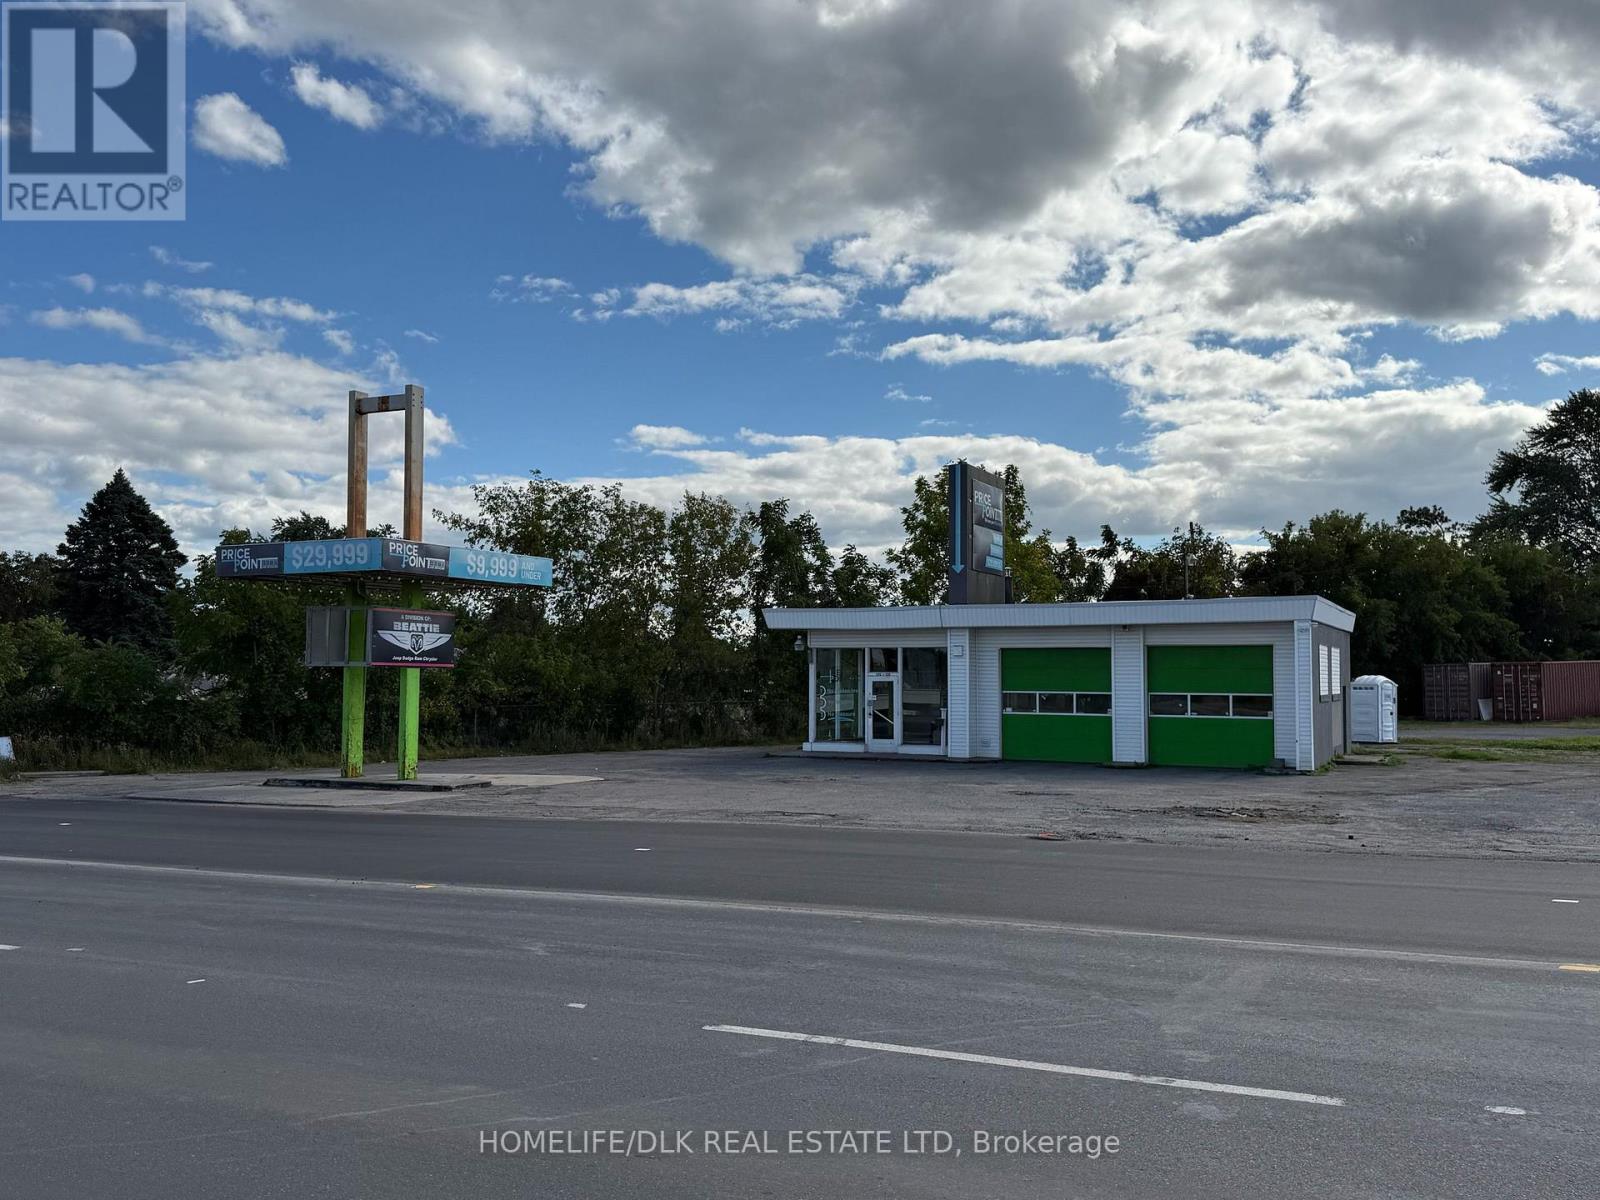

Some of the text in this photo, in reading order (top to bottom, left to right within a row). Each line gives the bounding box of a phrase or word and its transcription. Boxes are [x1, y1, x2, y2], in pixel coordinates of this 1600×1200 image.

[974, 490, 992, 507] PRICE
[221, 547, 251, 560] PRICE
[388, 542, 419, 556] PRICE
[291, 543, 368, 569] $29,999
[404, 555, 431, 569] POINT
[235, 558, 263, 571] POINT
[466, 551, 518, 578] $9,999
[521, 561, 535, 571] AND
[520, 571, 541, 580] UNDER
[393, 621, 440, 633] BEATTIE
